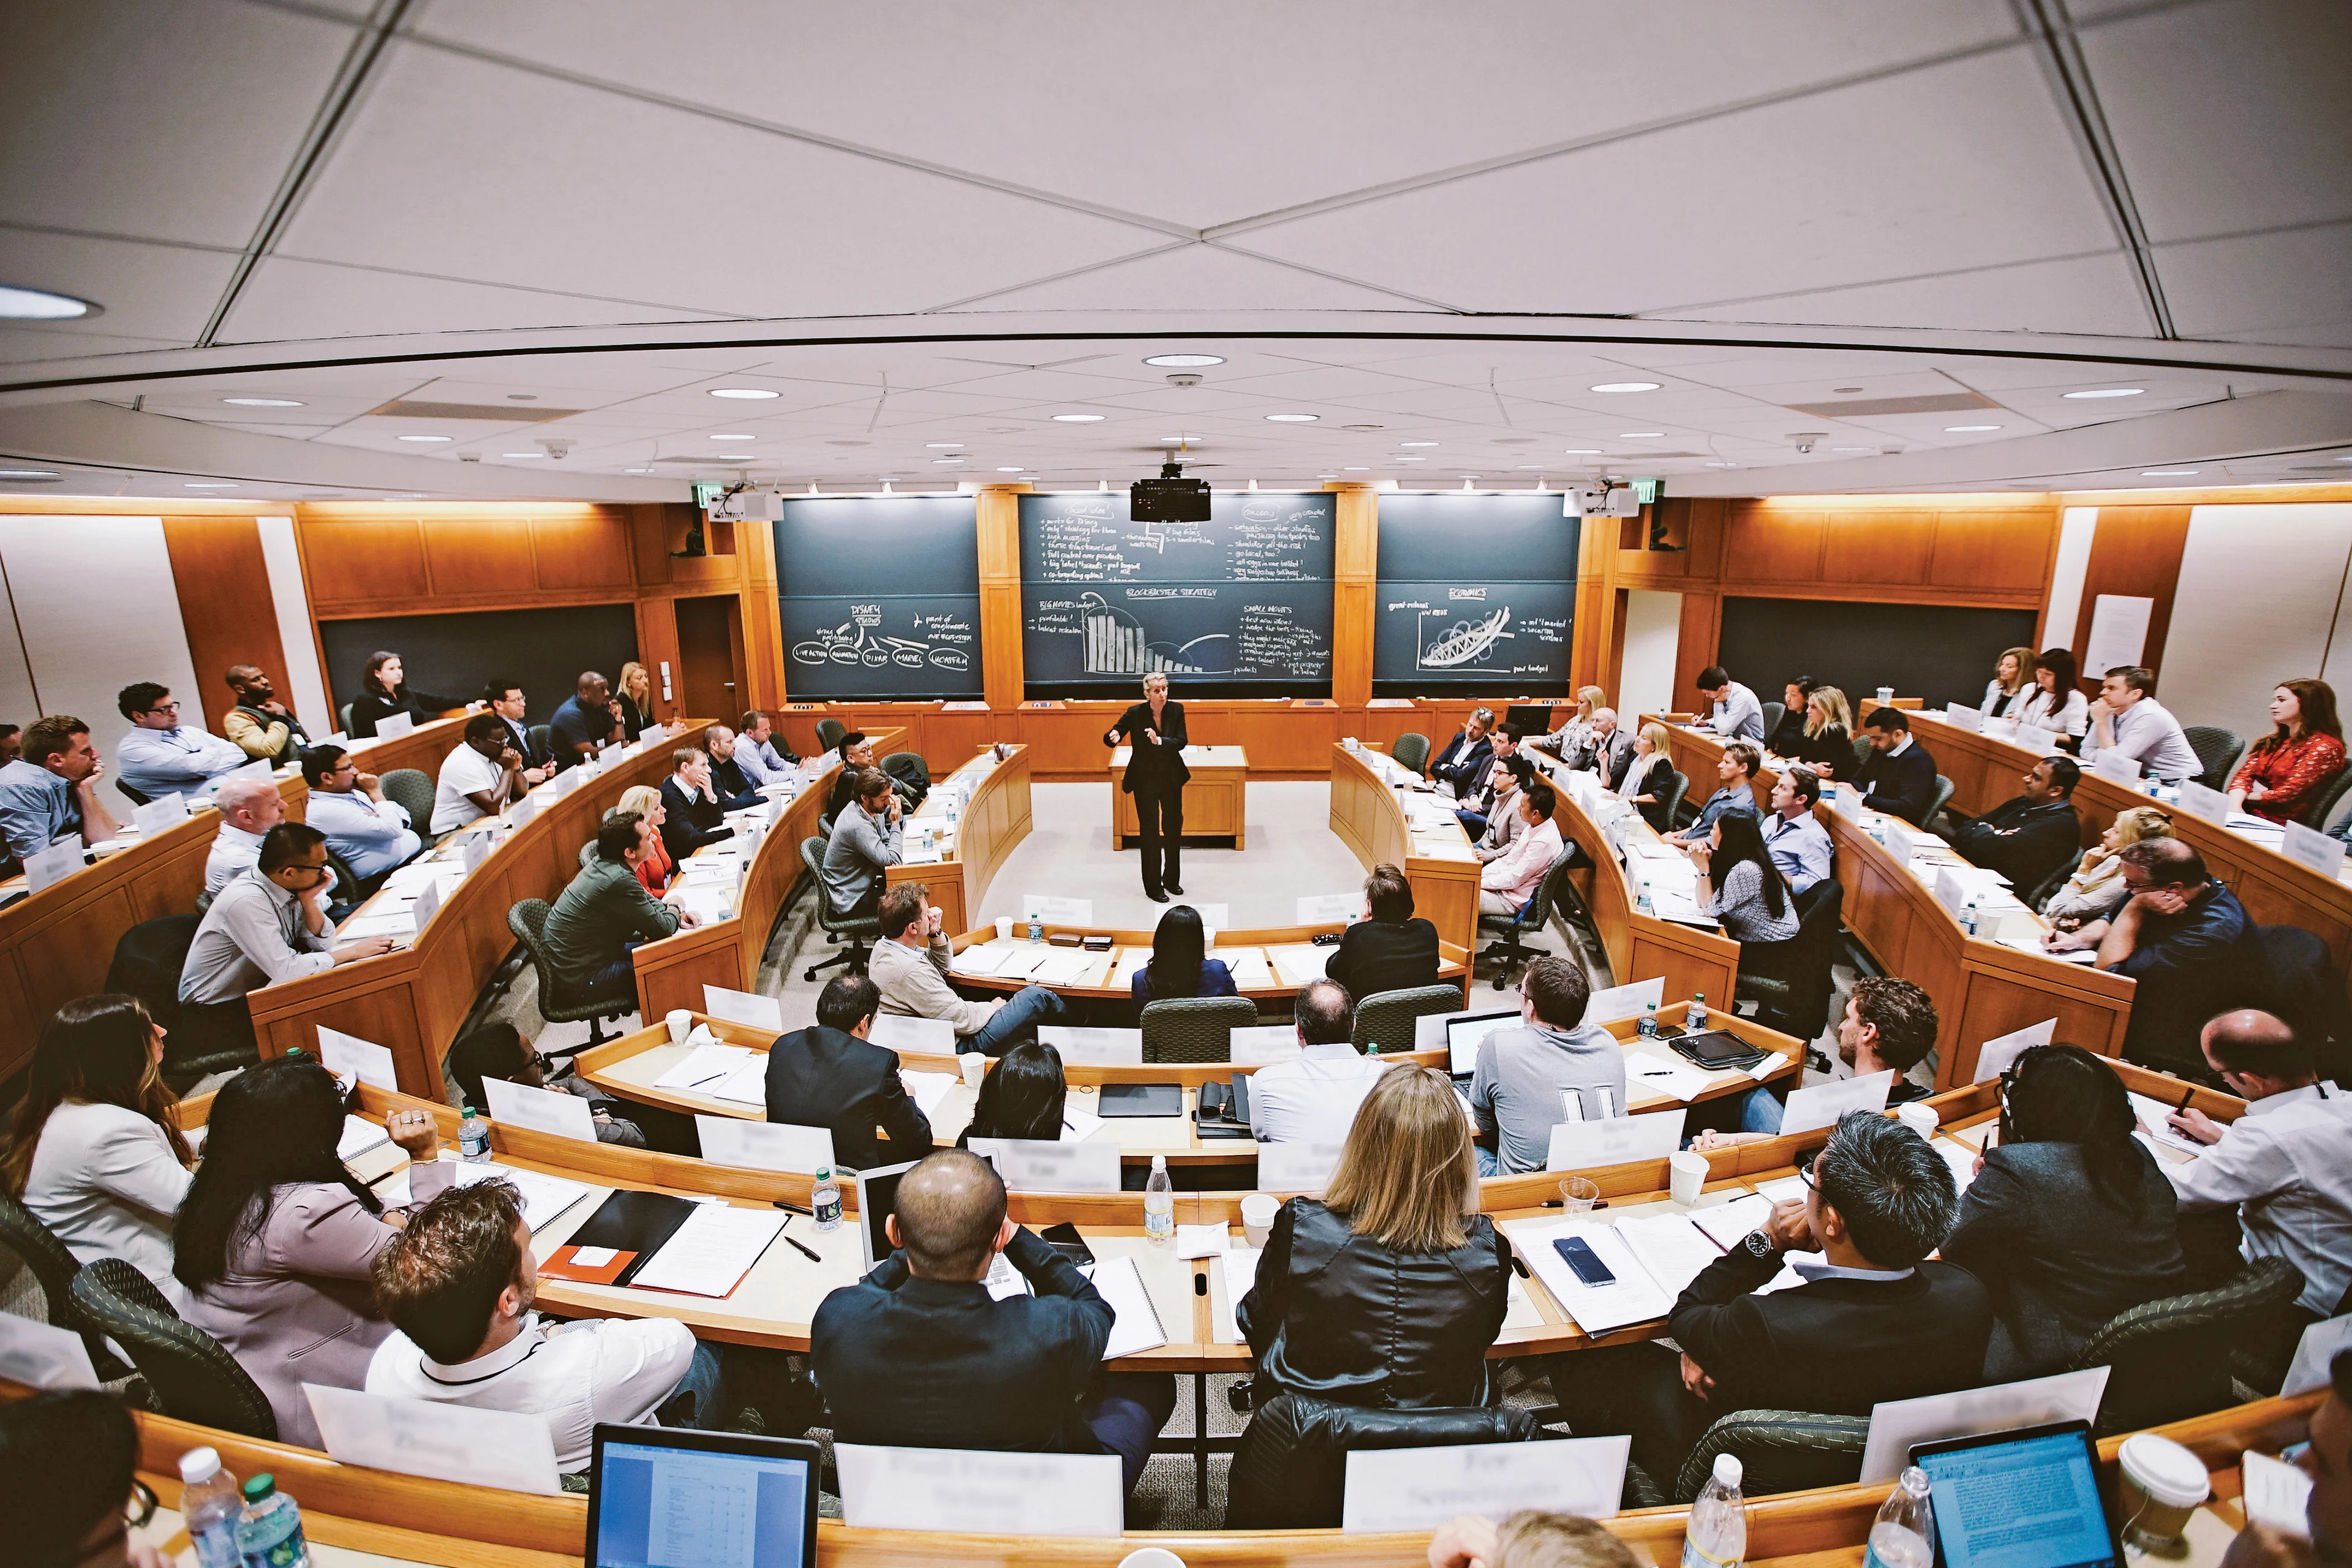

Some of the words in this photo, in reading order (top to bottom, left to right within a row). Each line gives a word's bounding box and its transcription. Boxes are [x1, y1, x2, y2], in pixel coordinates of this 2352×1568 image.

[1065, 526, 1090, 535] strategy
[1126, 588, 1178, 597] BLOCKBUSTER
[851, 604, 881, 614] DISNEY
[865, 654, 888, 663] PIXAR
[896, 655, 924, 663] MARVEL
[931, 655, 968, 666] LUCASFILM
